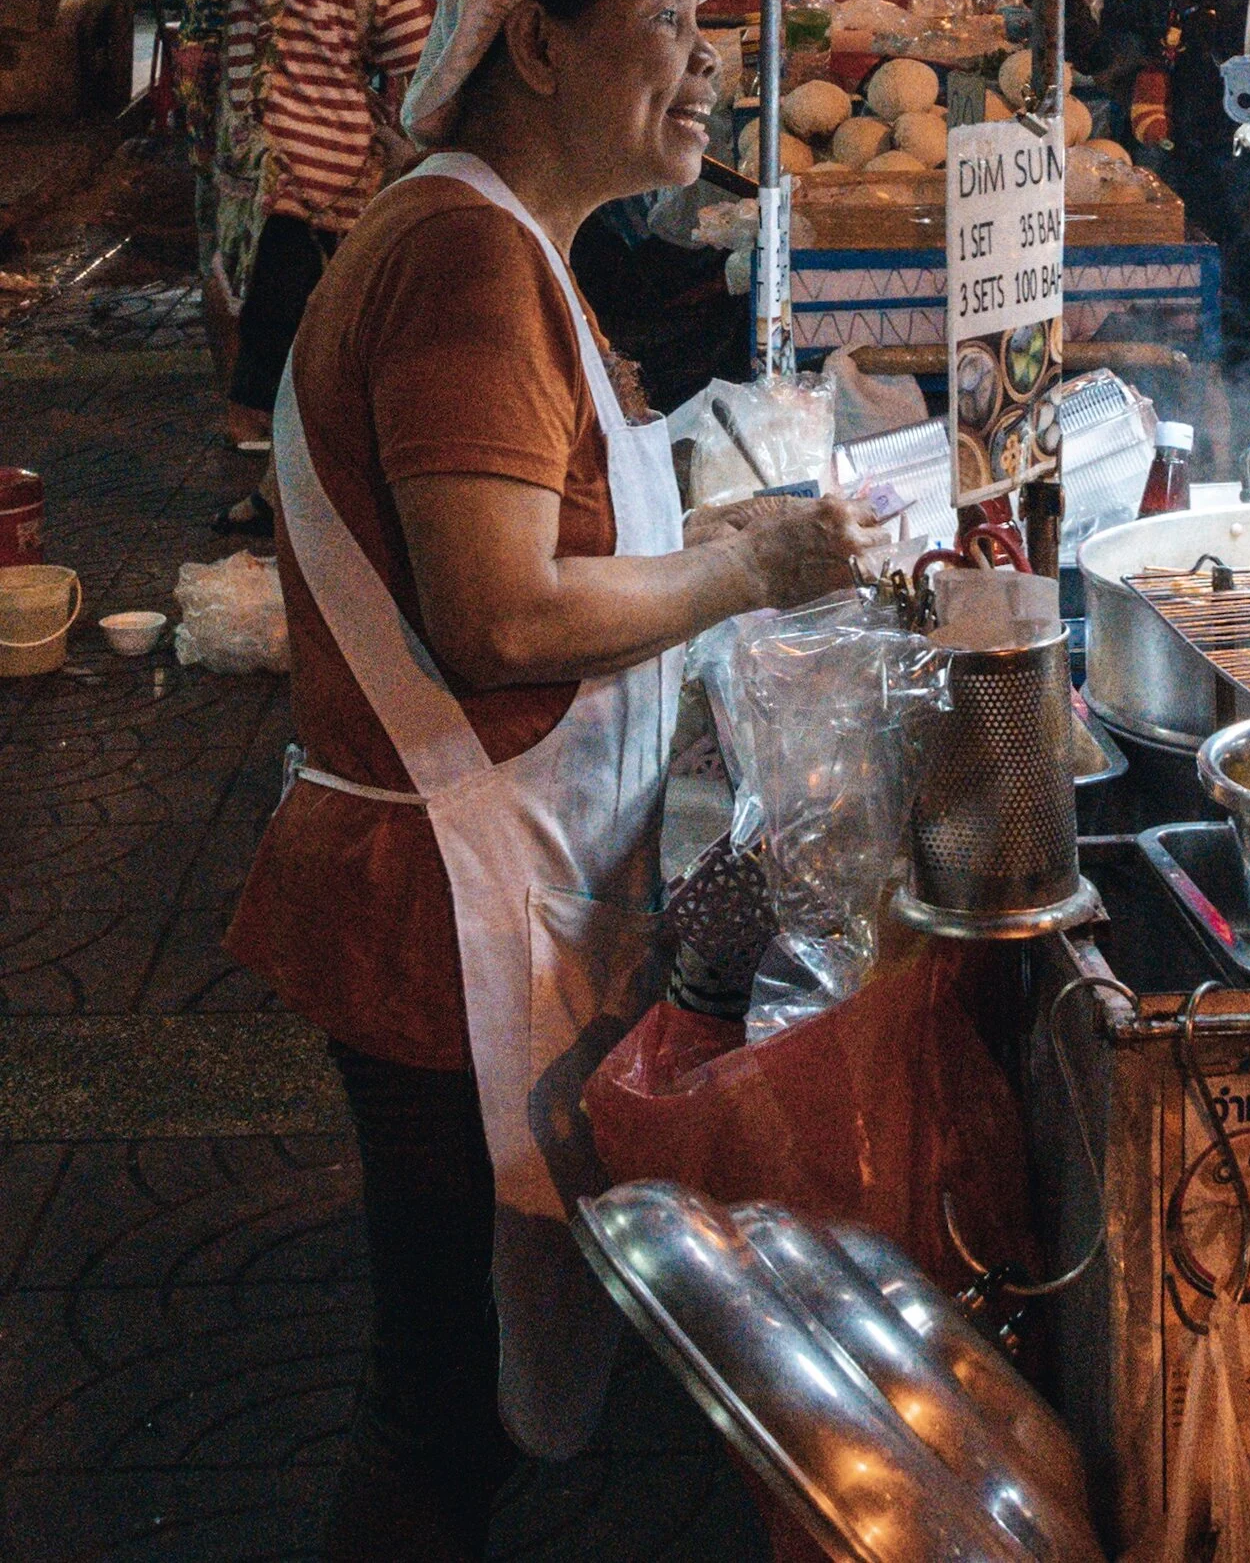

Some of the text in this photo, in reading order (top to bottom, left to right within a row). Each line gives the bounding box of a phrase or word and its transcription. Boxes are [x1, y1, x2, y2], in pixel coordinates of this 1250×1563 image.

[958, 144, 1064, 199] DIM SUN
[958, 226, 967, 262] 1
[971, 220, 995, 259] SET
[1019, 214, 1036, 249] 35
[958, 283, 969, 317] 3
[972, 274, 1006, 315] SETS
[1014, 268, 1038, 305] 100
